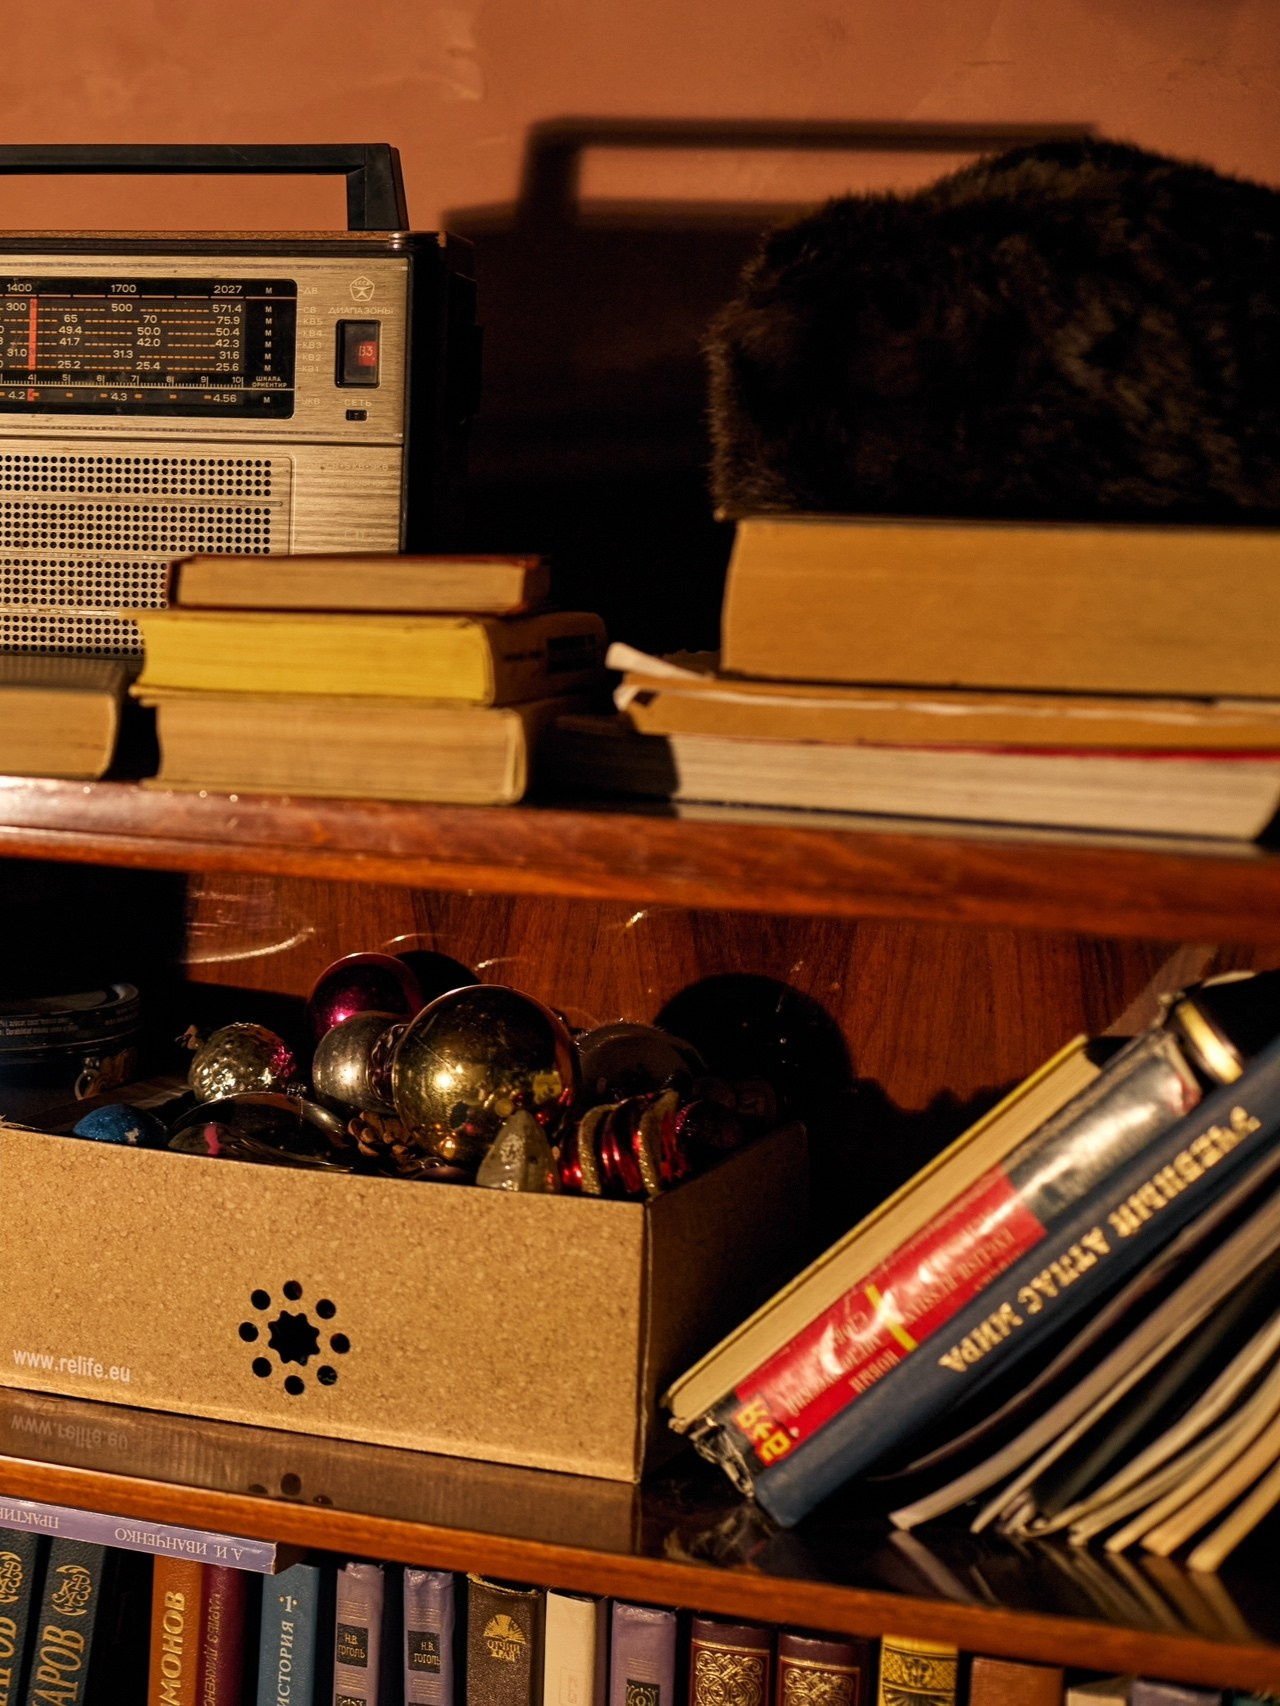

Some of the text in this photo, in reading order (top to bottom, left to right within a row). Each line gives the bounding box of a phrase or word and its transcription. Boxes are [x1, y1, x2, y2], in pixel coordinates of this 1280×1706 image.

[7, 283, 32, 292] 1400
[111, 284, 137, 293] 1700
[214, 285, 242, 294] 2027
[6, 302, 27, 311] 300
[111, 303, 133, 312] 500
[212, 304, 242, 313] 571.4
[328, 306, 394, 315] ДИАПАЗОНЫ
[64, 315, 78, 323] 65
[143, 315, 157, 324] 70
[217, 316, 240, 325] 75.9
[59, 326, 82, 334] 49.4
[137, 327, 161, 335] 50.0
[215, 328, 240, 337] 50.4
[59, 338, 81, 346] 41.7
[136, 338, 161, 347] 42.0
[215, 339, 240, 348] 42.3
[6, 348, 28, 357] 31.0
[113, 350, 133, 359] 31.3
[219, 351, 240, 360] 31.6
[57, 361, 80, 369] 25.2
[136, 362, 161, 370] 25.4
[215, 363, 239, 371] 25.6
[8, 391, 25, 400] 4.2
[111, 392, 127, 401] 4.3
[213, 394, 237, 402] 4.56
[343, 399, 373, 407] СЕТЬ
[1104, 1100, 1261, 1243] УЧЕБНЫЙ
[1012, 1223, 1115, 1318] АТЛАС
[934, 1299, 1025, 1383] МИРА
[13, 1350, 130, 1383] www.relife.eu
[114, 1527, 207, 1556] ИВАНЧЕНКО
[213, 1543, 228, 1559] И.
[230, 1547, 244, 1561] А.
[159, 1591, 185, 1706] МОНОВ
[338, 1644, 366, 1659] ГОГОЛЬ
[32, 1625, 85, 1706] АРОВ
[413, 1653, 441, 1666] ГОГОЛЬ
